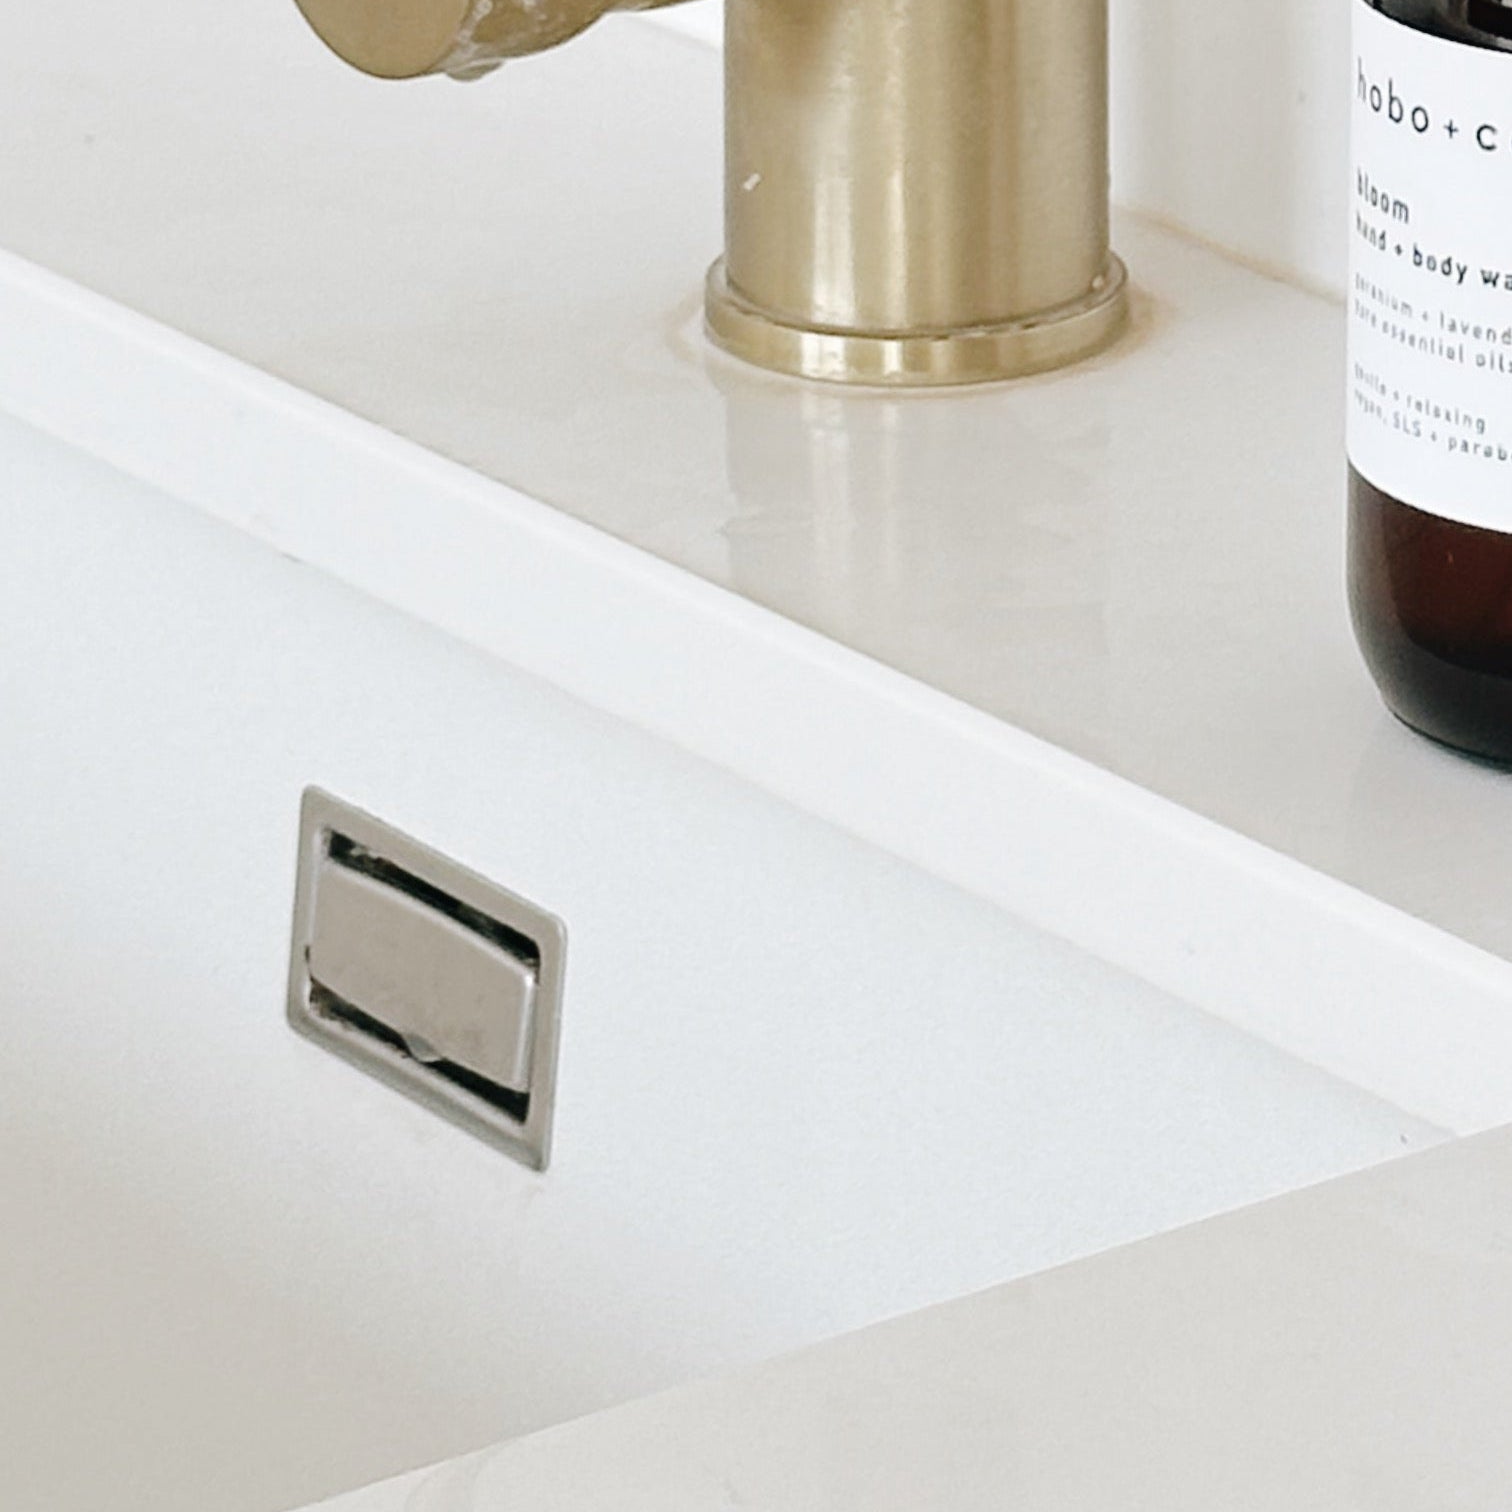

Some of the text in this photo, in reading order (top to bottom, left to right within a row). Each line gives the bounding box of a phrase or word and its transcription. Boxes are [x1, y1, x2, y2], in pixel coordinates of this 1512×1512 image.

[1413, 243, 1468, 285] body
[1382, 321, 1465, 364] essential
[1393, 410, 1422, 438] SLS
[1406, 393, 1487, 435] relaxing
